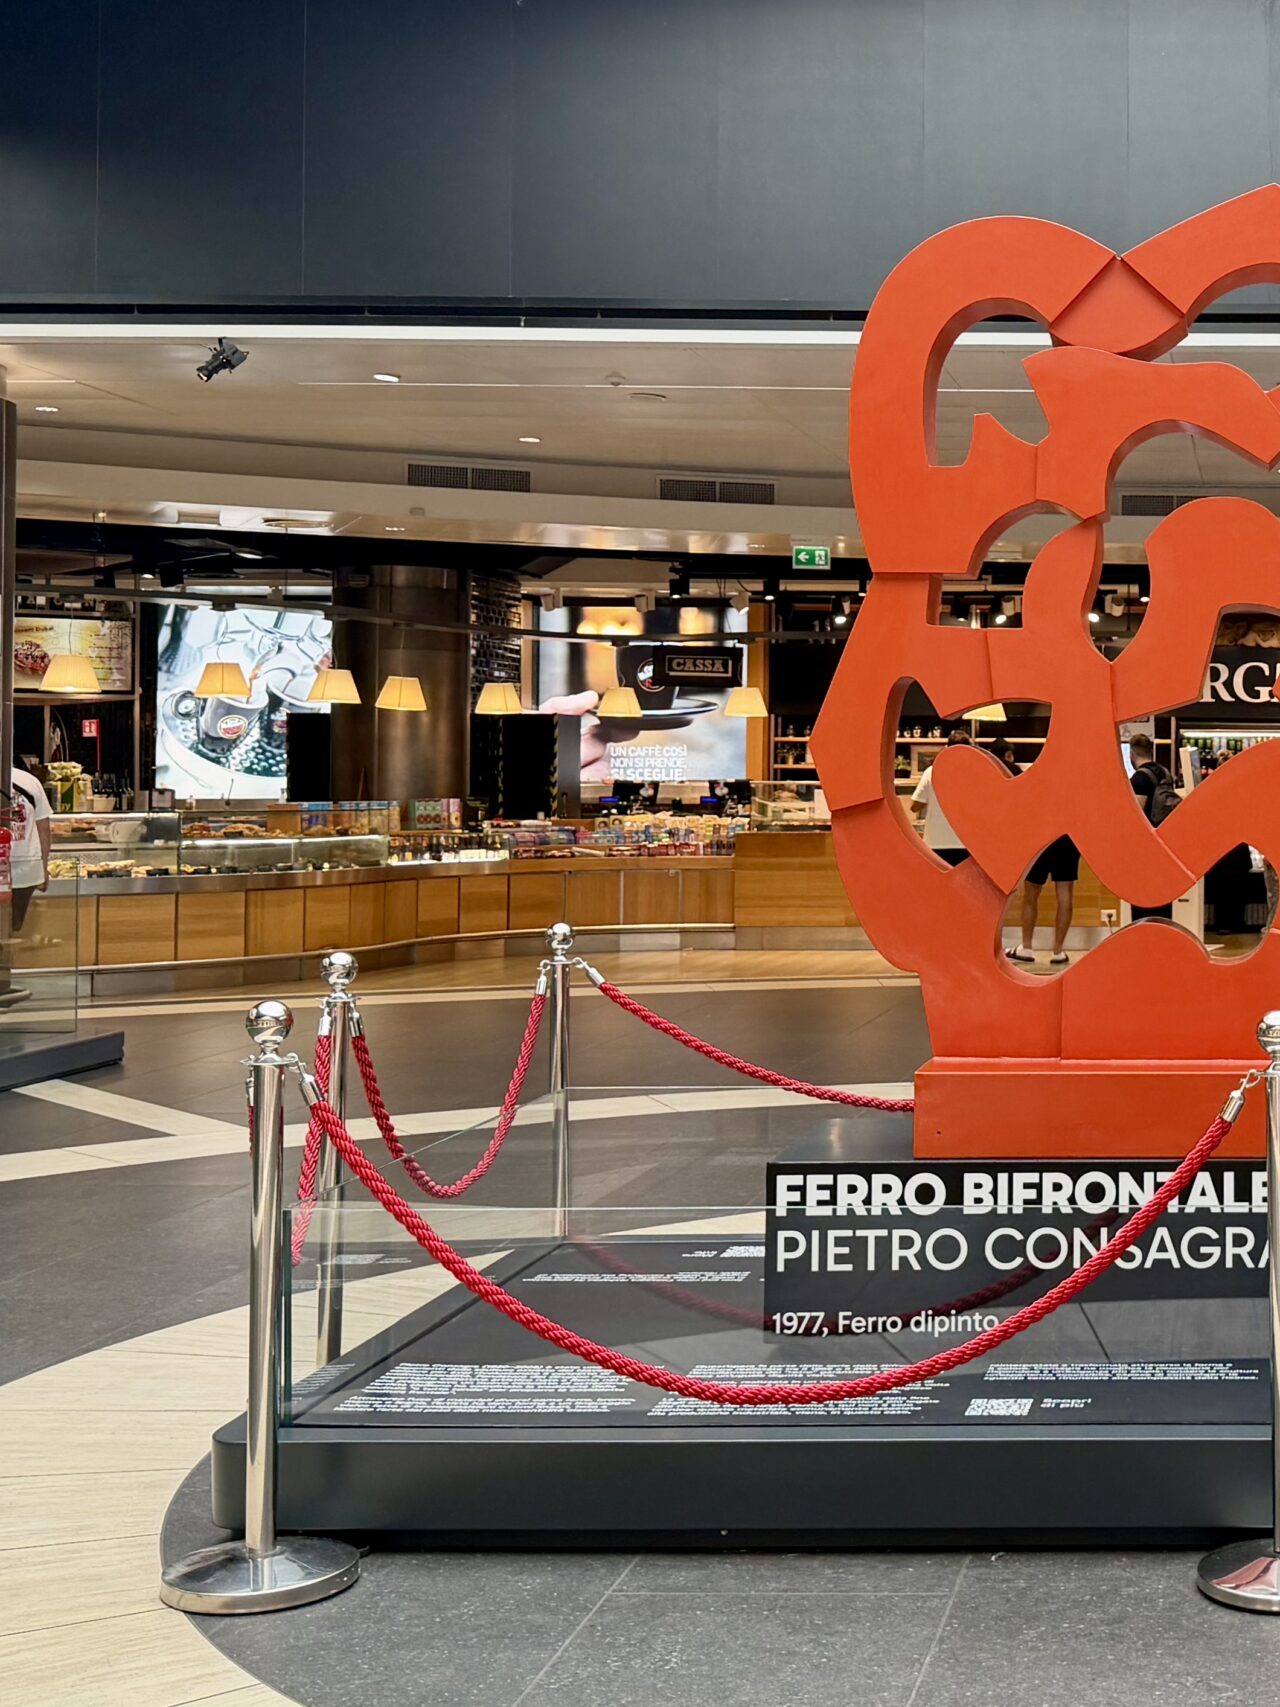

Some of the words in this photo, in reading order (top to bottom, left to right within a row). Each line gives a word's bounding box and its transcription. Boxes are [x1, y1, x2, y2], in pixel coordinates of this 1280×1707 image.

[672, 658, 725, 672] CASSA
[610, 746, 627, 757] UN
[628, 744, 662, 757] CAFFÈ
[610, 757, 634, 768] NON
[775, 1172, 947, 1216] FERRO
[776, 1227, 969, 1272] PIETRO
[772, 1311, 829, 1338] 1977,
[837, 1311, 903, 1334] Ferro
[910, 1310, 1000, 1338] dipinto
